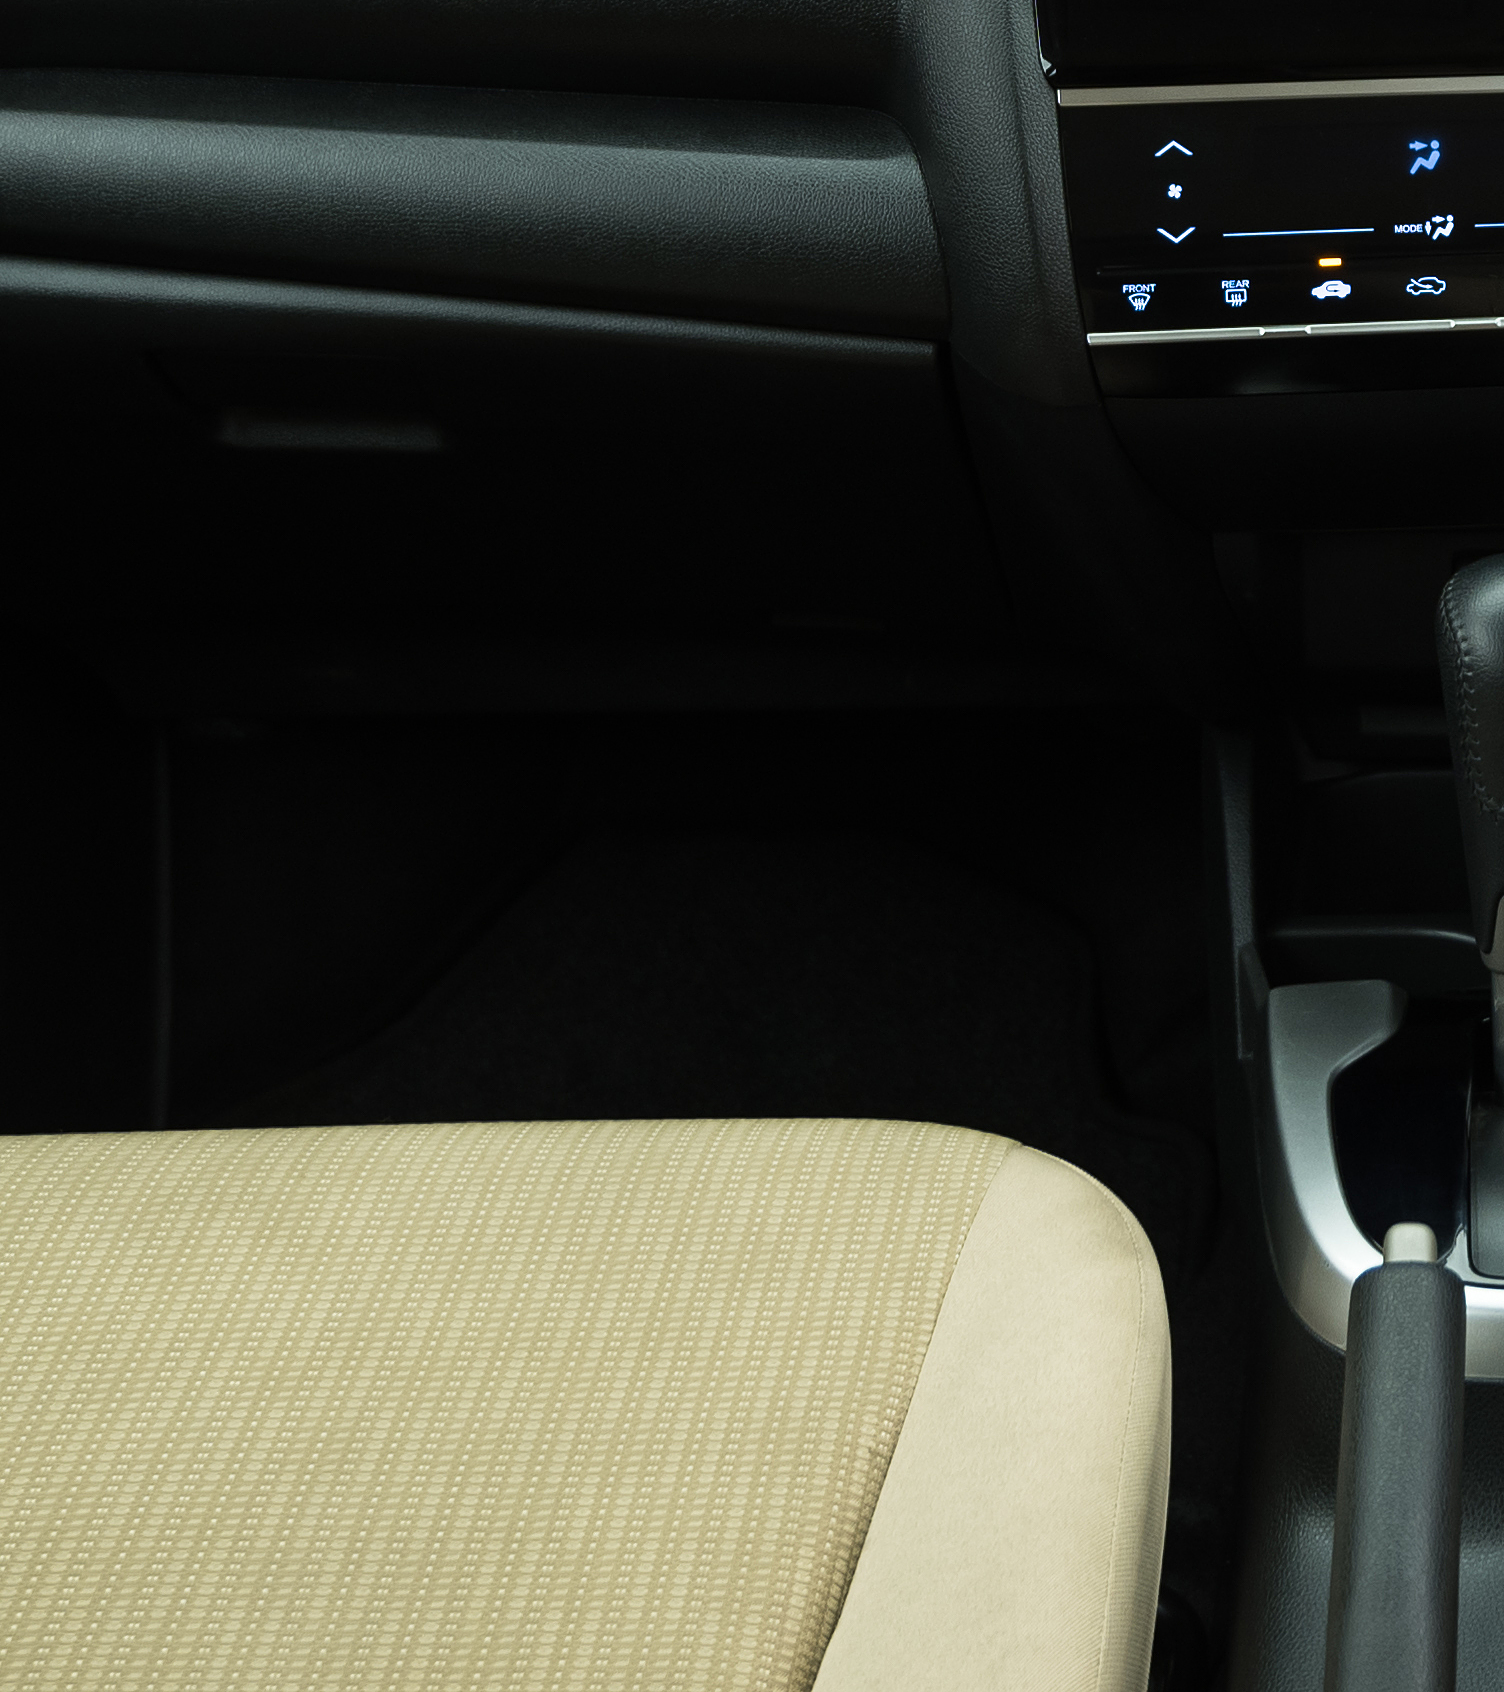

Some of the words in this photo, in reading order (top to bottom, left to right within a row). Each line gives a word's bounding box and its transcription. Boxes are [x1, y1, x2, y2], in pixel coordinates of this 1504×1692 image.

[1394, 223, 1423, 234] MODE
[1122, 284, 1157, 293] FRONT
[1221, 280, 1250, 289] REAR
